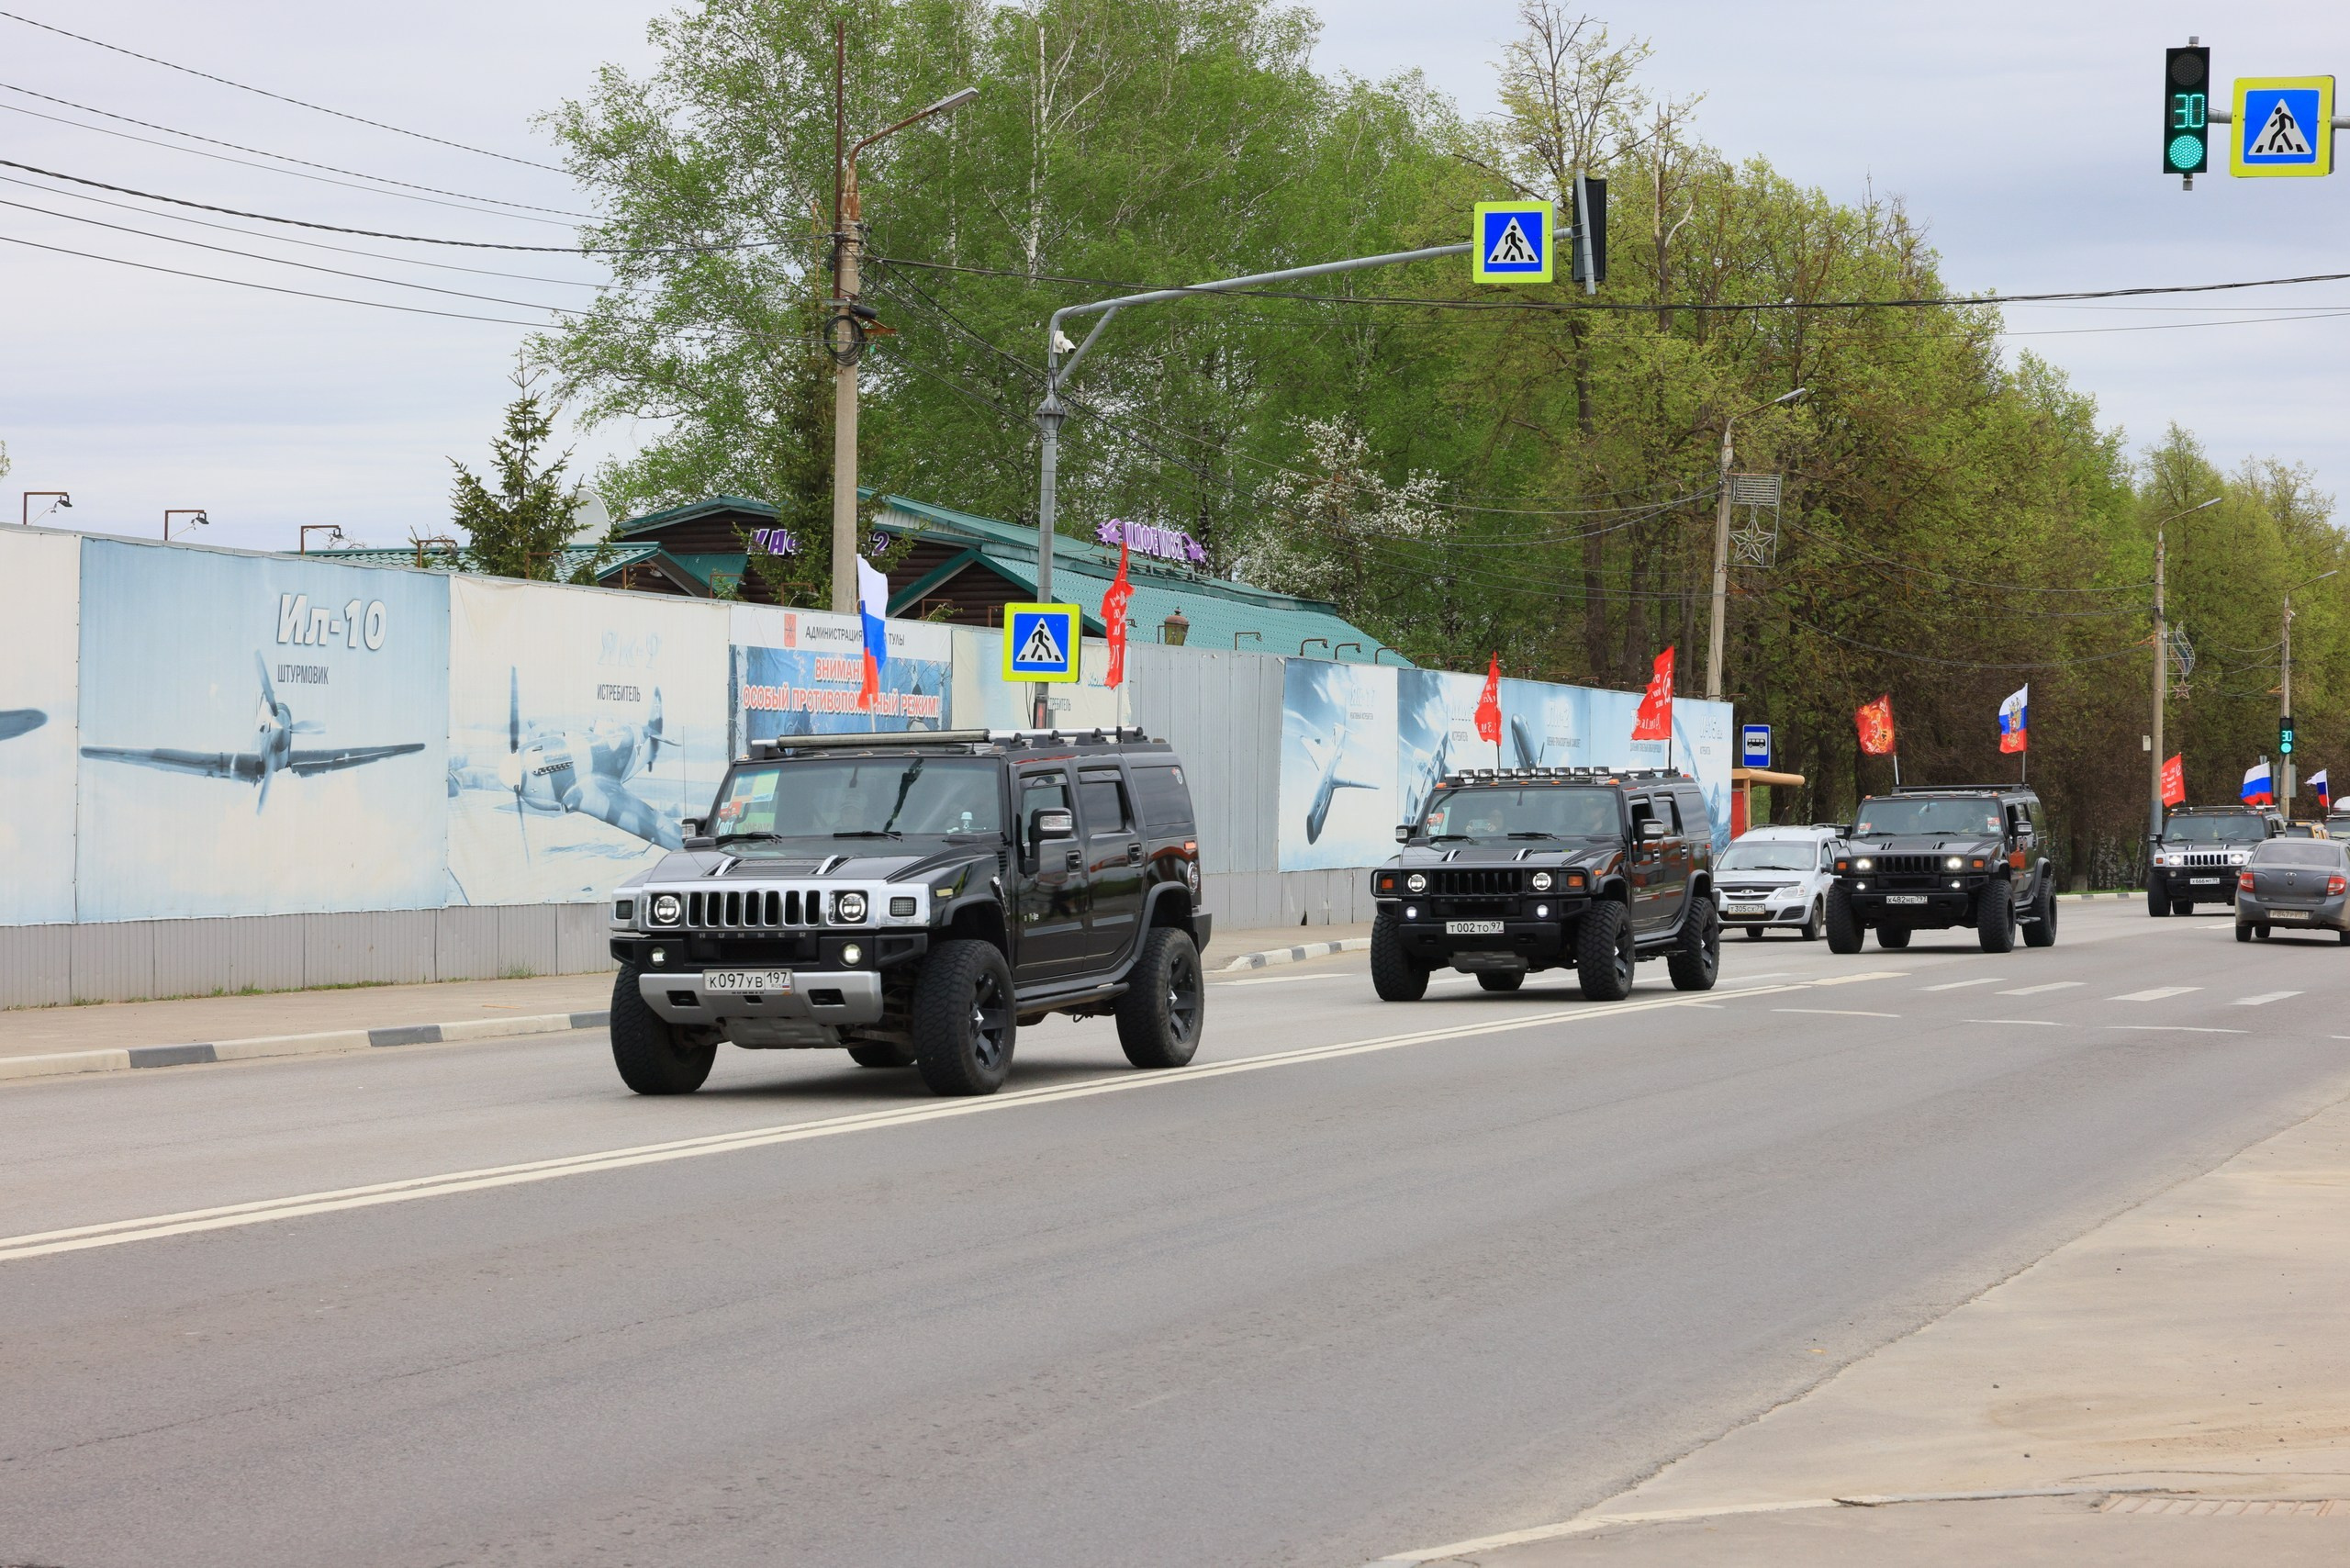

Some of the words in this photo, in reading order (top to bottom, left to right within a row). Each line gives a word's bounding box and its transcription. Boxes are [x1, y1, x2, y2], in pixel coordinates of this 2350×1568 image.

[2174, 94, 2204, 129] 30
[1125, 521, 1158, 555] КАФЕ
[276, 593, 386, 651] Ил-10
[805, 626, 863, 644] АДМИНИСТРАЦИЯ
[888, 633, 905, 646] ТУЛЫ
[277, 664, 329, 685] ШТУРМОВИК
[814, 656, 865, 684] ВНИМАН
[597, 684, 641, 702] ИСТРЕБИТЕЛЬ
[743, 683, 789, 711] ОСОБЫЙ
[791, 688, 900, 716] ПРОТИВОПОНЫЙ
[901, 694, 940, 717] РЕЖИМ!
[2281, 730, 2293, 742] 30
[709, 973, 763, 989] К097УВ
[767, 972, 788, 983] 197
